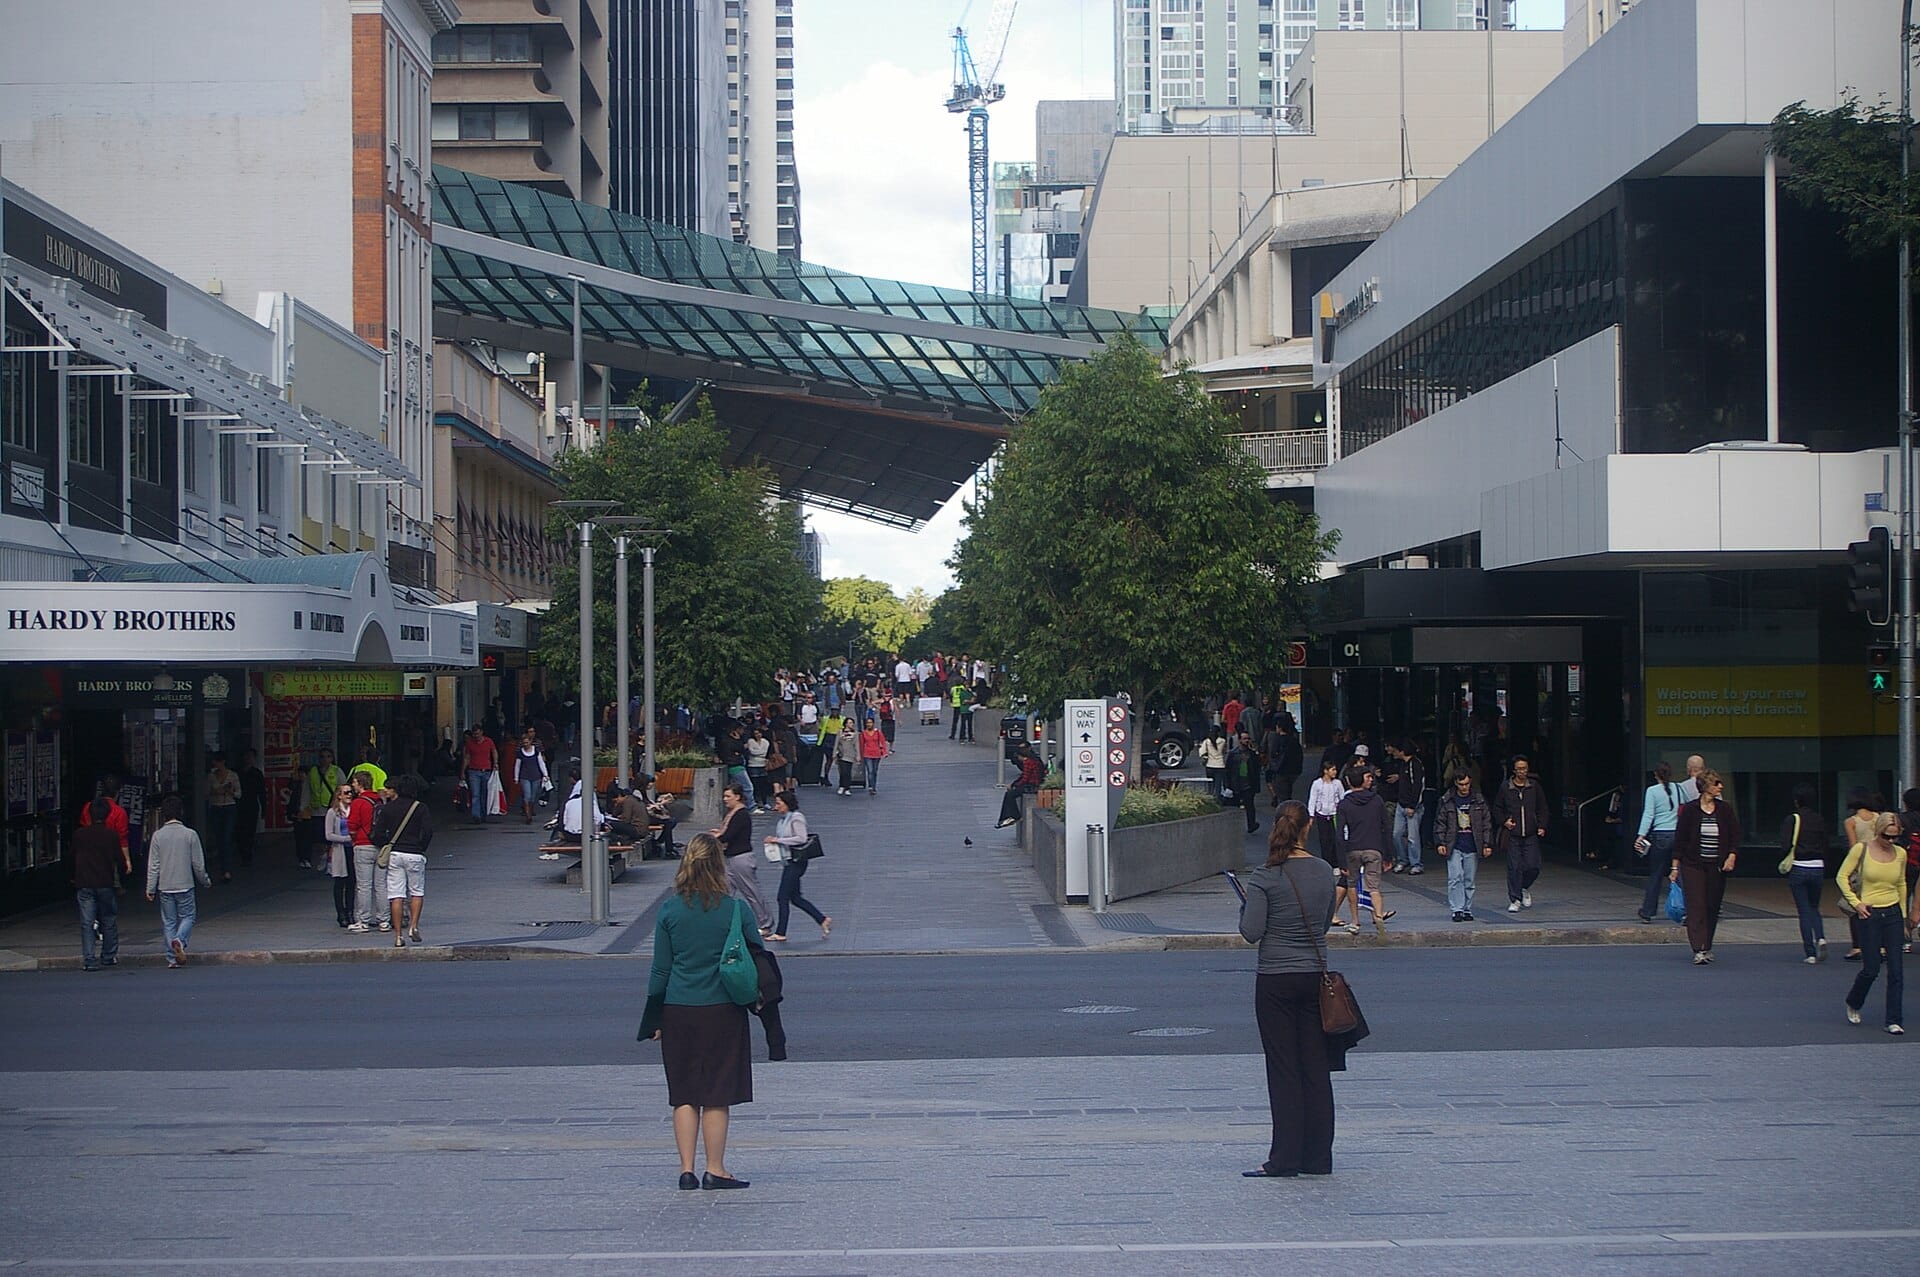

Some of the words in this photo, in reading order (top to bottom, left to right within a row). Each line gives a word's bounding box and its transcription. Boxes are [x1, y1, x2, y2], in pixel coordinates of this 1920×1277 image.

[45, 234, 77, 274] HARDY
[77, 249, 121, 296] BROTHERS
[7, 609, 108, 630] HARDY
[113, 610, 236, 632] BROTHERS
[293, 672, 318, 683] CITY
[321, 672, 352, 683] MALL
[355, 672, 377, 683] INN
[77, 680, 123, 692] HARDY
[126, 680, 193, 692] BROERS
[152, 694, 193, 702] JEWELLERS
[1656, 687, 1718, 700] Welcome
[1723, 688, 1738, 700] to
[1742, 689, 1773, 703] your
[1776, 689, 1807, 700] new
[1076, 710, 1095, 719] ONE
[1656, 703, 1681, 716] and
[1685, 703, 1751, 718] improved
[1755, 703, 1809, 716] branch.
[1076, 720, 1096, 729] WAY
